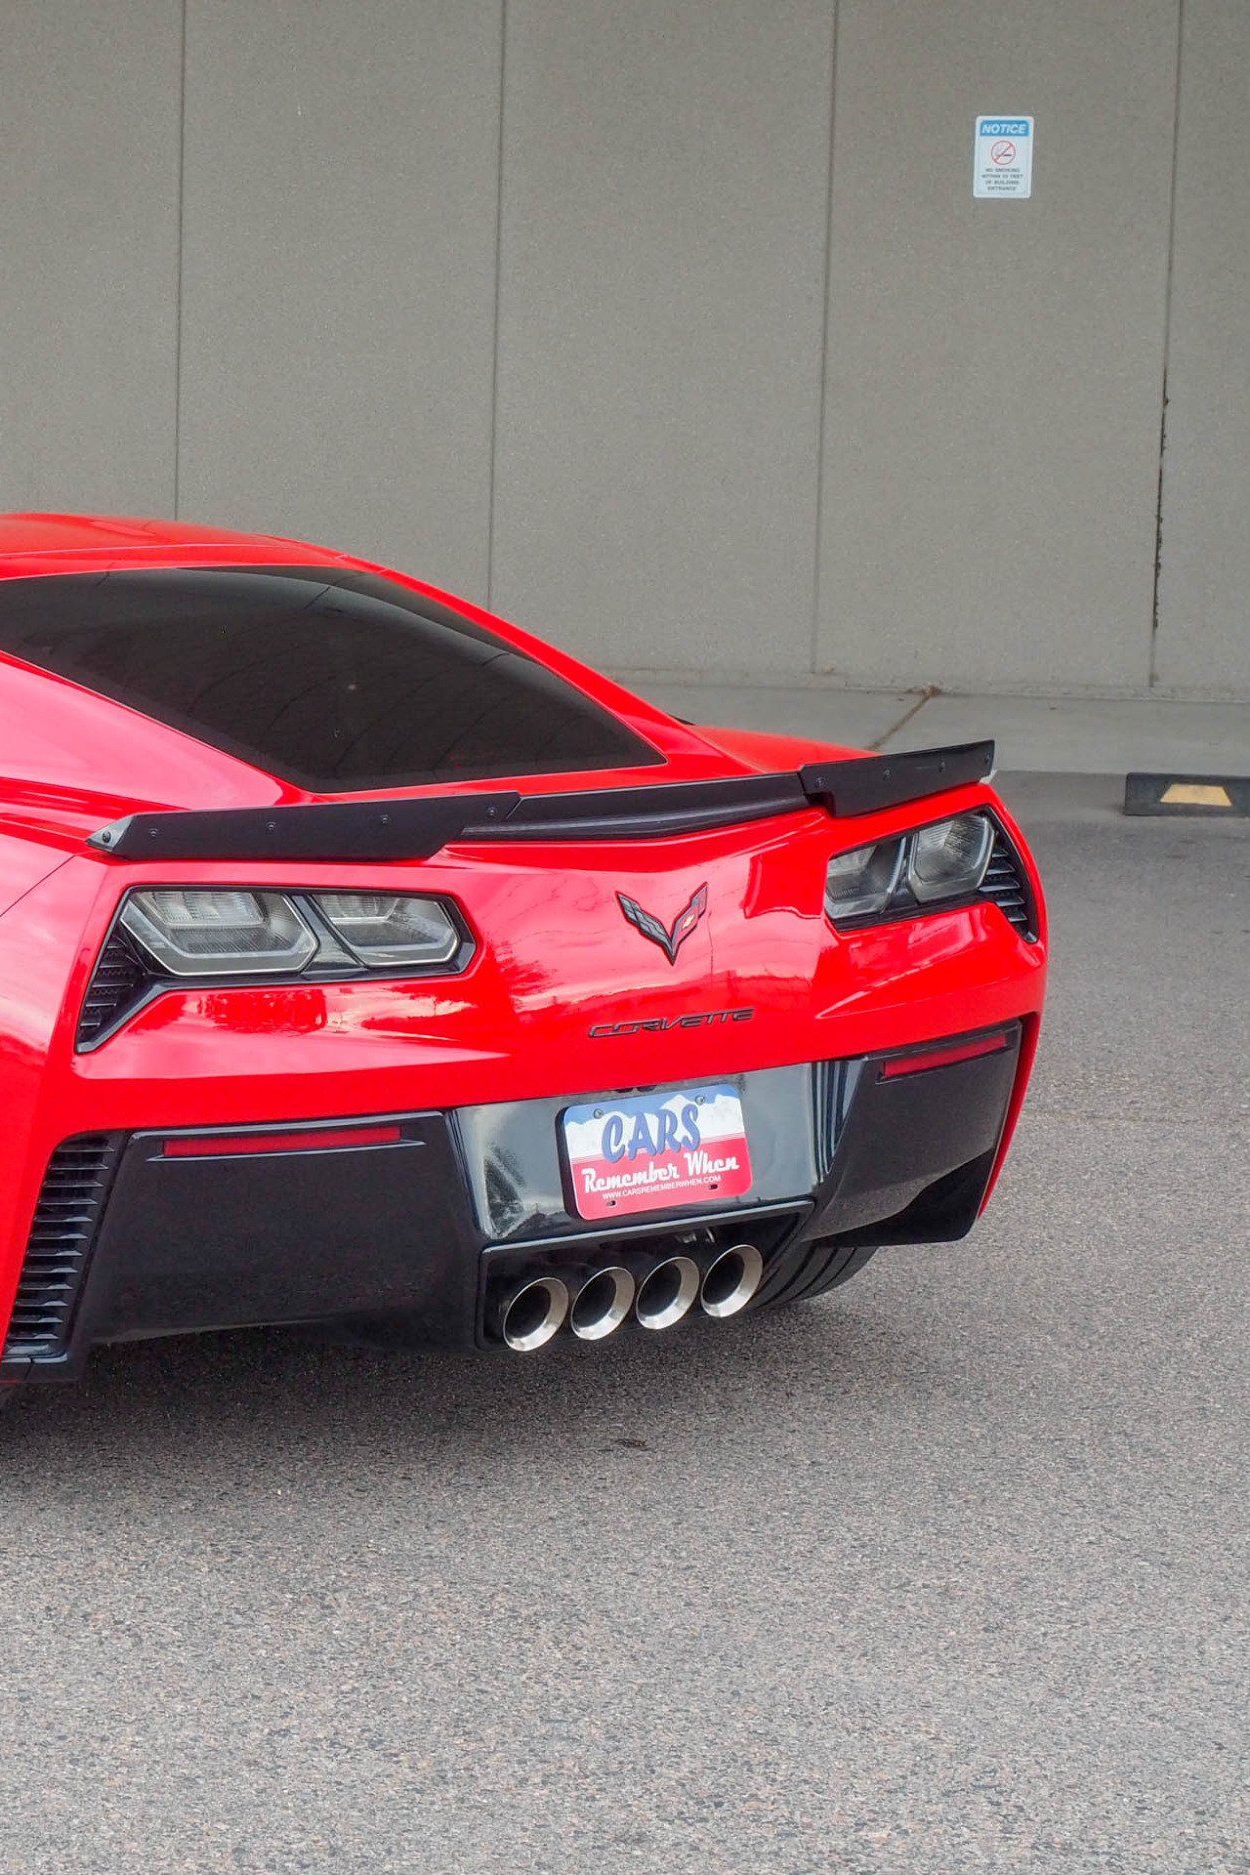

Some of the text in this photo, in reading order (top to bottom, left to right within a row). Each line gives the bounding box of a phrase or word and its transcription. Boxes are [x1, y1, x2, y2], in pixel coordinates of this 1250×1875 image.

[981, 123, 1027, 134] NOTICE
[589, 1007, 755, 1037] CORVETTE
[601, 1104, 701, 1163] CARS
[581, 1151, 740, 1193] Remember When
[602, 1175, 722, 1200] WWW.CARSREMEMBERWHEN.COM
